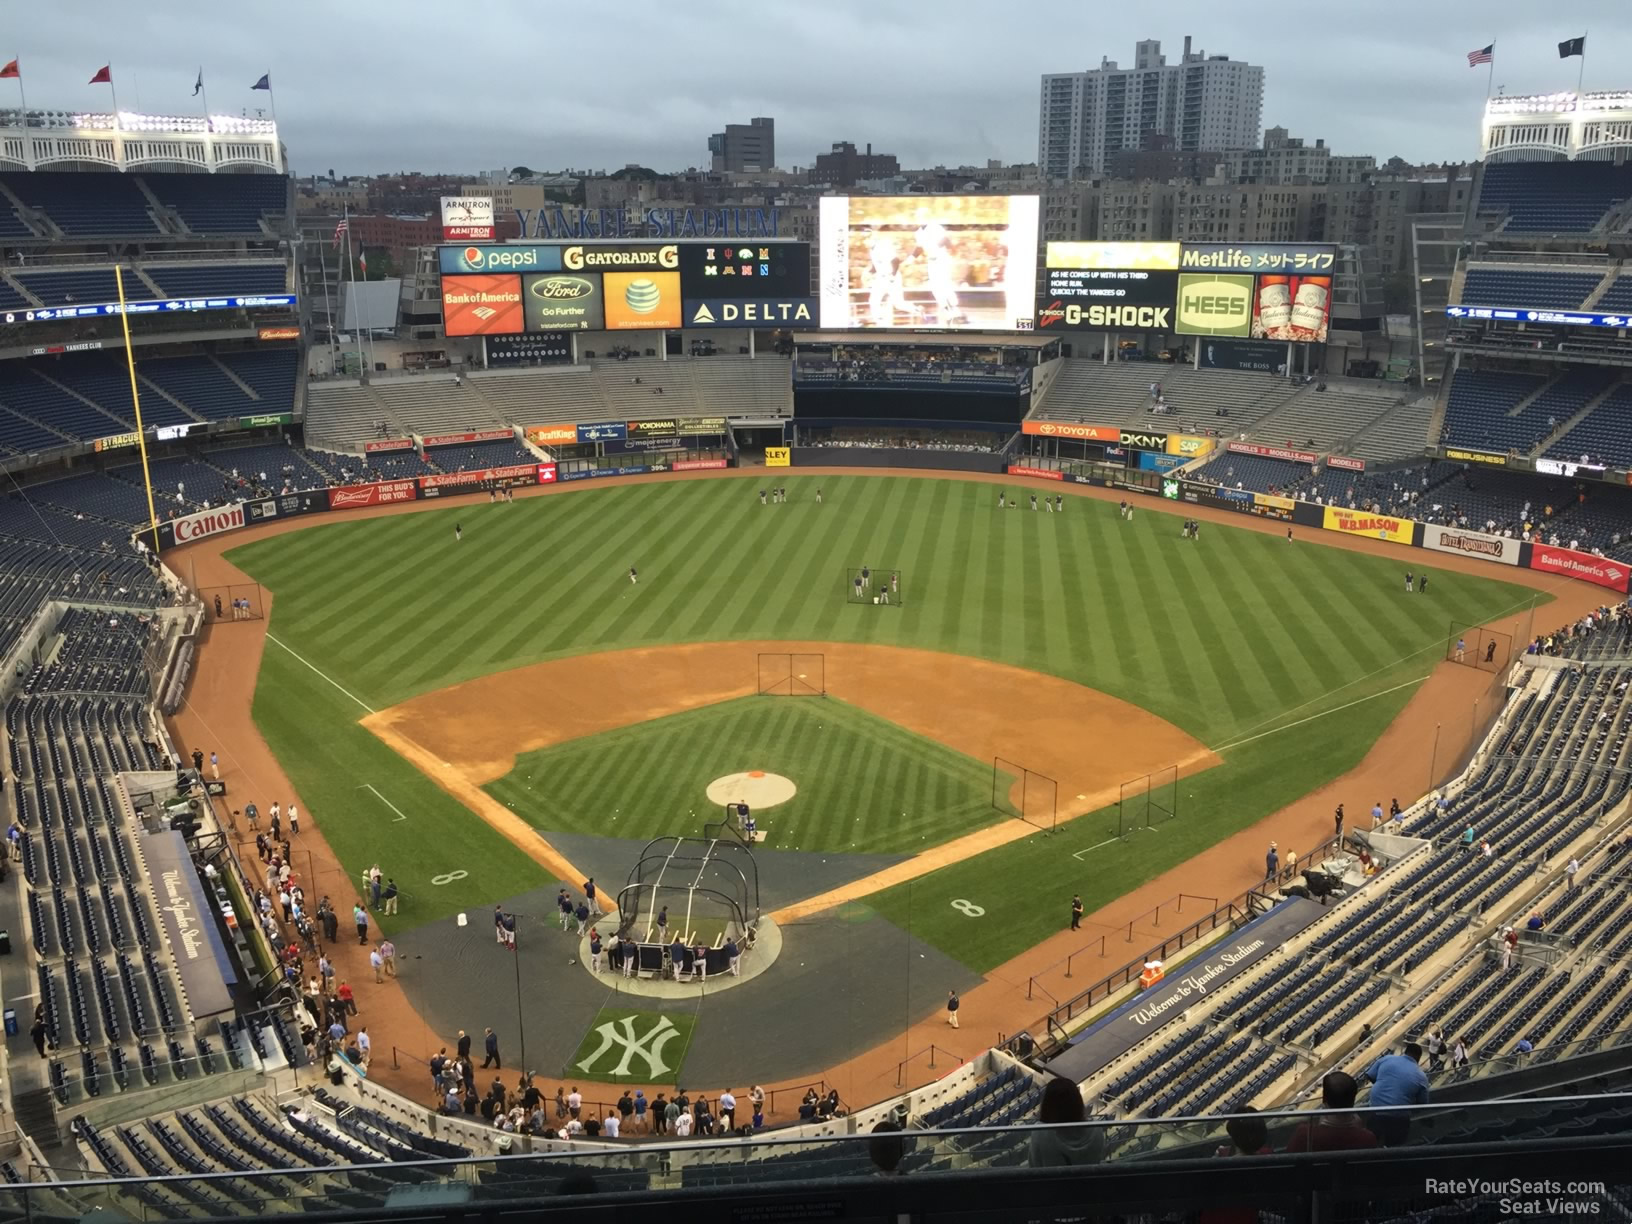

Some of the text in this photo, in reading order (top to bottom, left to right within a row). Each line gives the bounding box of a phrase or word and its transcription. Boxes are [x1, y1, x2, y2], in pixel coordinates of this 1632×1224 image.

[445, 201, 491, 209] ARMITRON
[515, 208, 780, 239] YANKEE STADIUM
[450, 227, 491, 235] ARMITRON
[488, 249, 538, 268] pepsi
[586, 252, 657, 266] GATORADE
[1182, 249, 1252, 268] MetLife
[1256, 252, 1335, 269] メットライフ
[543, 280, 581, 297] Ford
[445, 292, 520, 304] Bank of America
[542, 307, 585, 316] Go Further
[723, 303, 811, 321] DELTA
[1184, 295, 1245, 316] HESS
[1065, 304, 1171, 328] G-SHOCK
[66, 343, 89, 352] YANKEES
[1239, 361, 1270, 370] THE BOSS
[638, 421, 676, 430] YOKOHAMA
[1057, 425, 1098, 437] TOYOTA
[102, 432, 141, 447] SYRACUS
[539, 430, 576, 440] DraftKings
[1120, 433, 1167, 449] DKNY
[1106, 446, 1124, 456] FedEx
[1180, 441, 1199, 452] SAP
[1230, 443, 1258, 453] MODELL'S
[1330, 457, 1361, 468] MODELL'S
[377, 481, 414, 493] THIS BUD'S
[379, 491, 409, 501] FOR YOU.
[175, 509, 243, 541] Canon
[1440, 533, 1459, 548] HOTEL
[1494, 540, 1503, 557] 2
[1541, 554, 1604, 577] Bank of America
[1128, 937, 1265, 1025] Welcome to Yankee Stadium
[575, 1014, 681, 1080] NY
